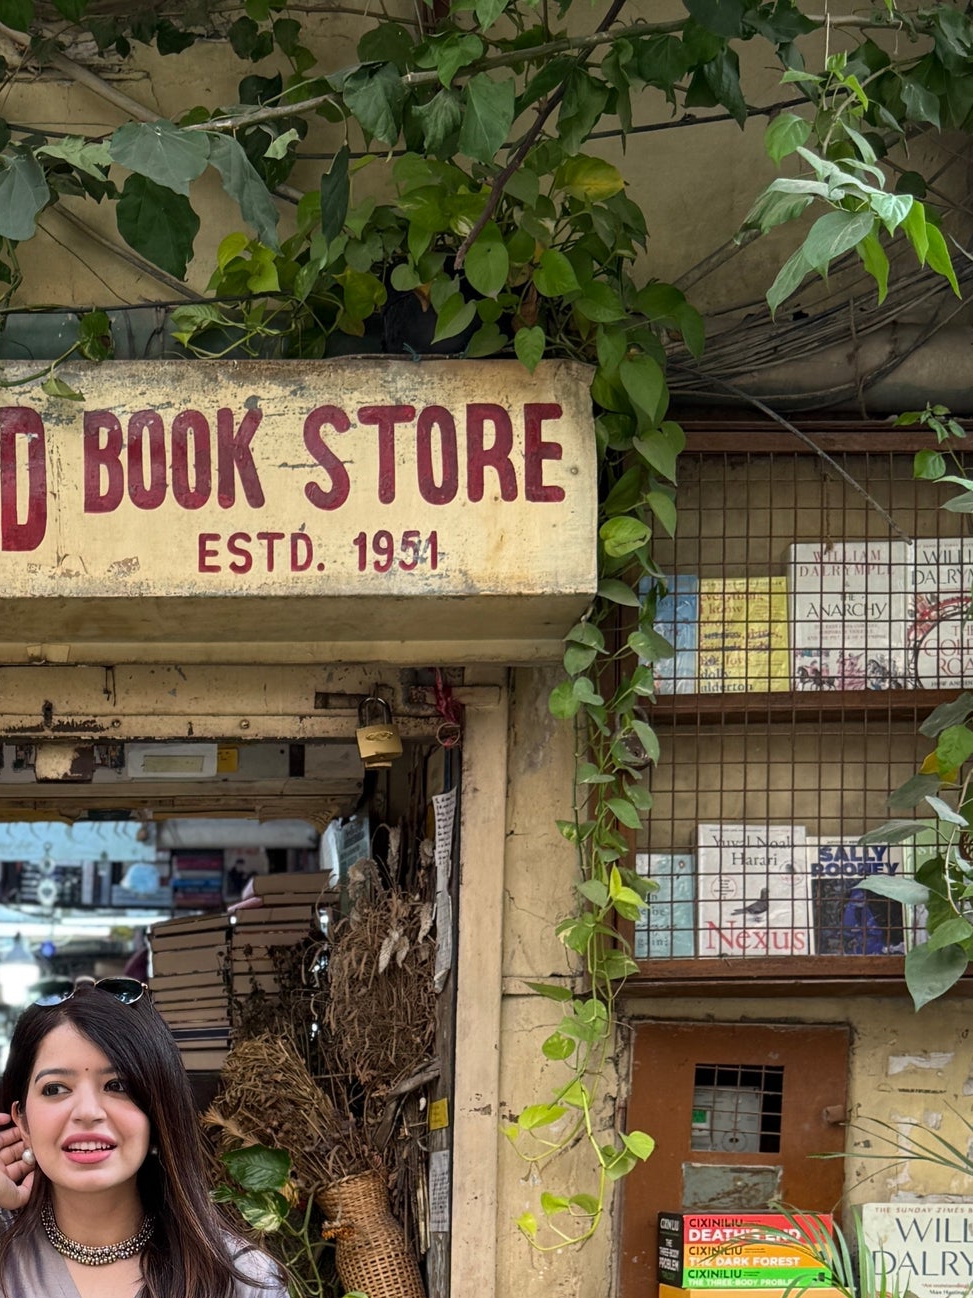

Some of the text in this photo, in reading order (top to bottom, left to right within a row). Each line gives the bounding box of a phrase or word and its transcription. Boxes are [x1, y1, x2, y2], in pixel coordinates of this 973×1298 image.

[83, 402, 265, 513] BOOK
[303, 402, 566, 511] STORE
[198, 530, 439, 574] ESTD. 1951
[813, 549, 881, 563] WILLIAM
[841, 593, 854, 601] HE
[806, 602, 888, 620] ANARCHY
[712, 834, 751, 849] Yuval
[732, 852, 778, 866] Harari
[819, 845, 888, 862] SALLY
[811, 862, 899, 877] ROONEY
[706, 920, 805, 951] Nexus
[895, 1217, 973, 1242] WILL
[715, 1256, 749, 1267] DARK
[752, 1256, 801, 1267] FOREST
[760, 1279, 800, 1287] PROBLE
